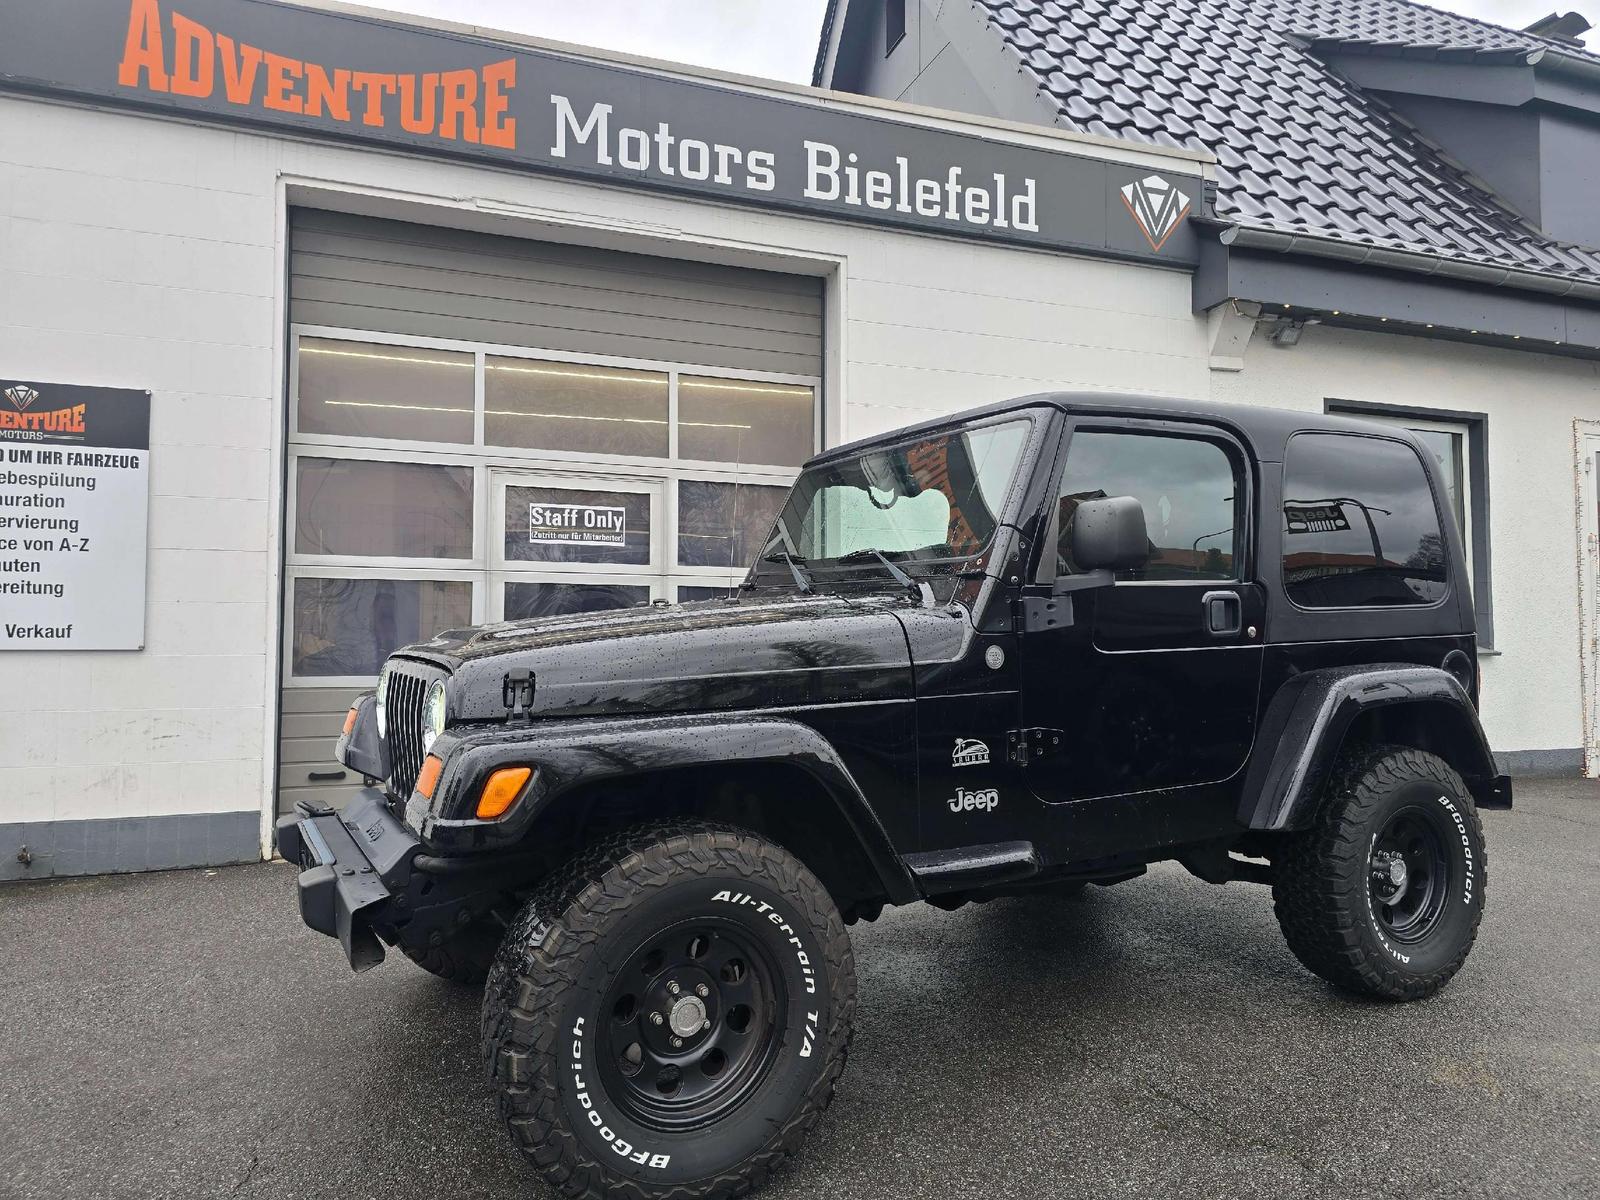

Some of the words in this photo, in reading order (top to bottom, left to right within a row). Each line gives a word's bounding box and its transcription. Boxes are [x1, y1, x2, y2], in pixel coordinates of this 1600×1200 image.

[118, 0, 516, 150] ADVENTURE
[550, 94, 776, 192] Motors
[803, 140, 1039, 233] Bielefeld
[9, 449, 32, 463] UM
[37, 450, 63, 465] IHR
[67, 452, 140, 469] FAHRZEUG
[0, 470, 96, 491] ebespülung
[0, 493, 65, 508] uration
[0, 515, 79, 533] ervierung
[531, 507, 578, 527] Staff
[584, 509, 623, 533] Only
[23, 539, 54, 551] von
[59, 537, 89, 552] A-Z
[571, 532, 582, 541] für
[0, 558, 41, 573] uten
[0, 580, 64, 598] reitung
[5, 624, 73, 638] Verkauf
[948, 787, 999, 813] Jeep
[1438, 795, 1475, 905] BFGoodrich
[711, 890, 816, 995] All-Terrain
[800, 1010, 819, 1058] T/A
[571, 1016, 671, 1169] BFGoodrich
